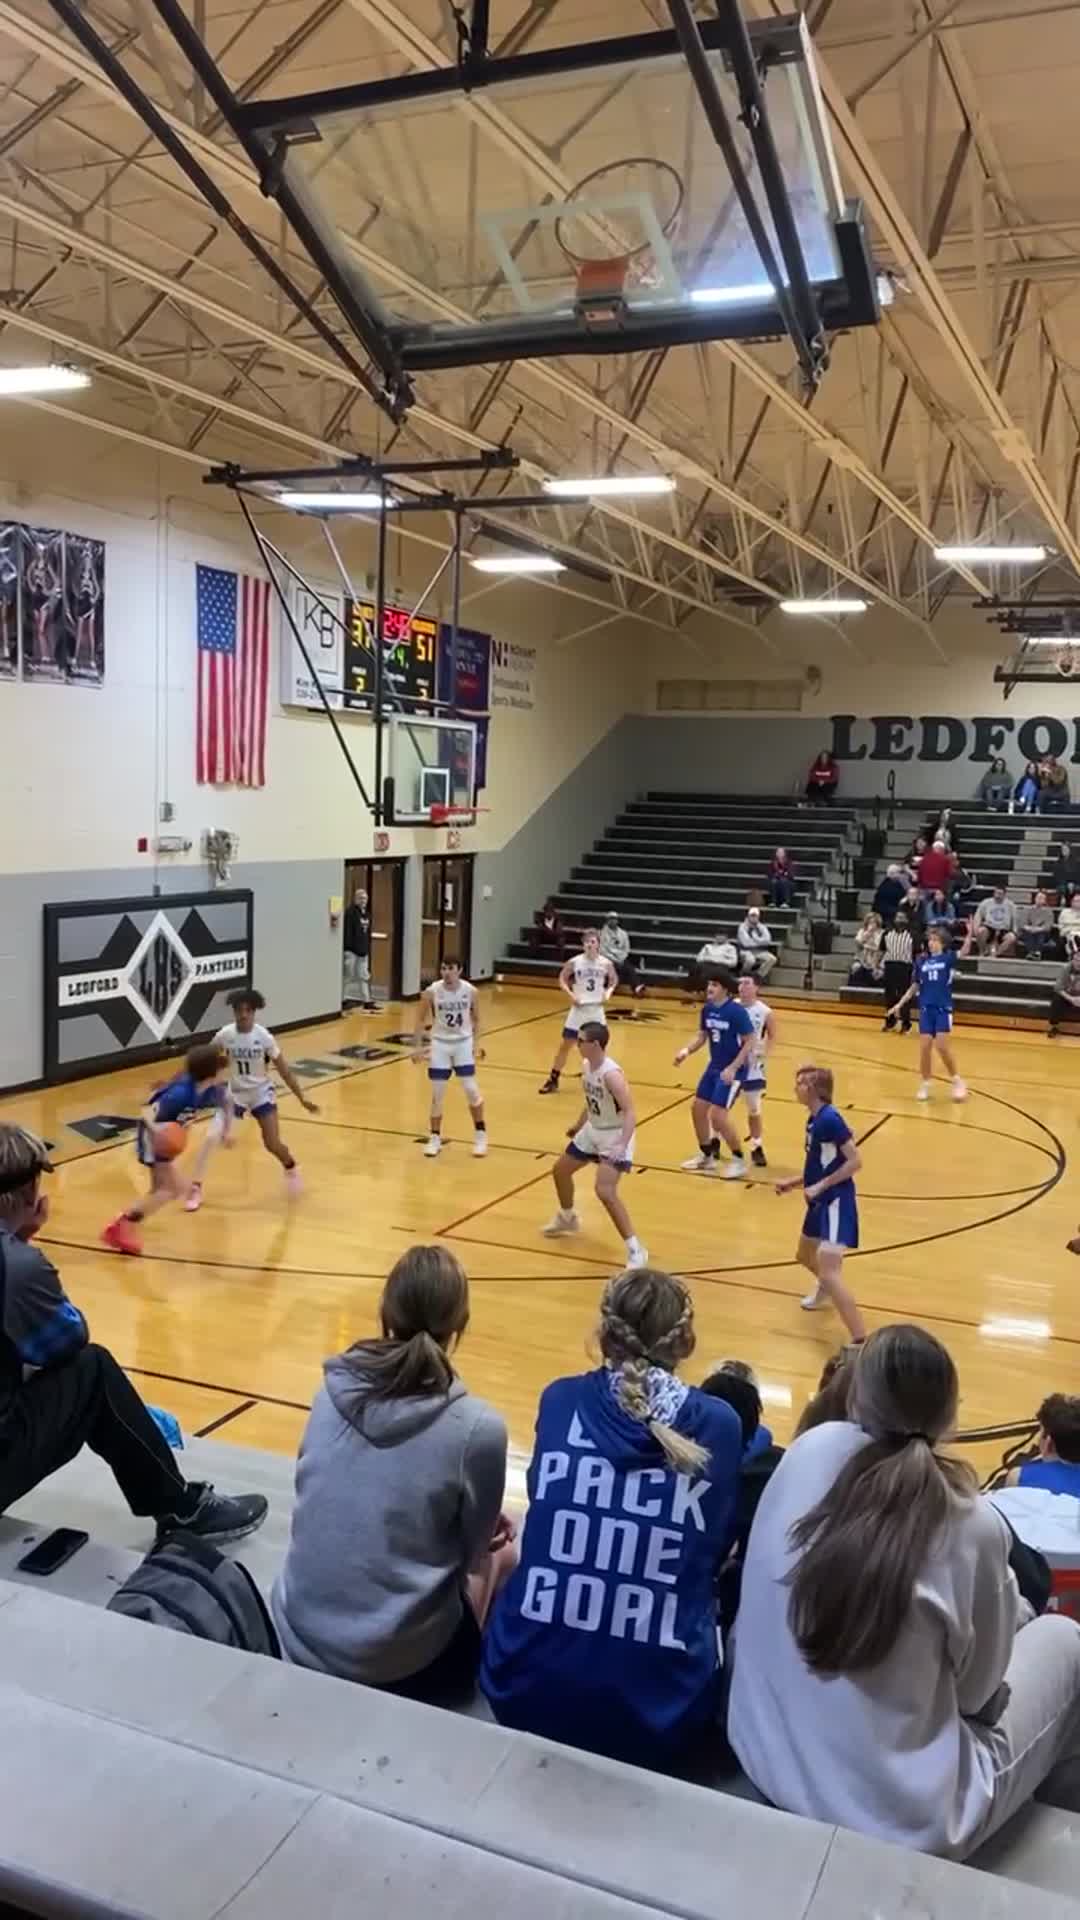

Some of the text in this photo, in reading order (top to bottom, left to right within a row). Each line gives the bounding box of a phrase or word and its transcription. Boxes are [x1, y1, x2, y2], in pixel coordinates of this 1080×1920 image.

[416, 634, 433, 661] 51
[830, 714, 1080, 764] LEDFO
[195, 957, 245, 978] PANTHERS
[67, 976, 119, 998] LEDFORD
[586, 978, 596, 992] 3
[445, 1013, 464, 1028] 24
[237, 1060, 250, 1075] 11
[535, 1450, 713, 1533] PACK
[549, 1508, 684, 1585] ONE
[520, 1565, 688, 1651] GOAL
